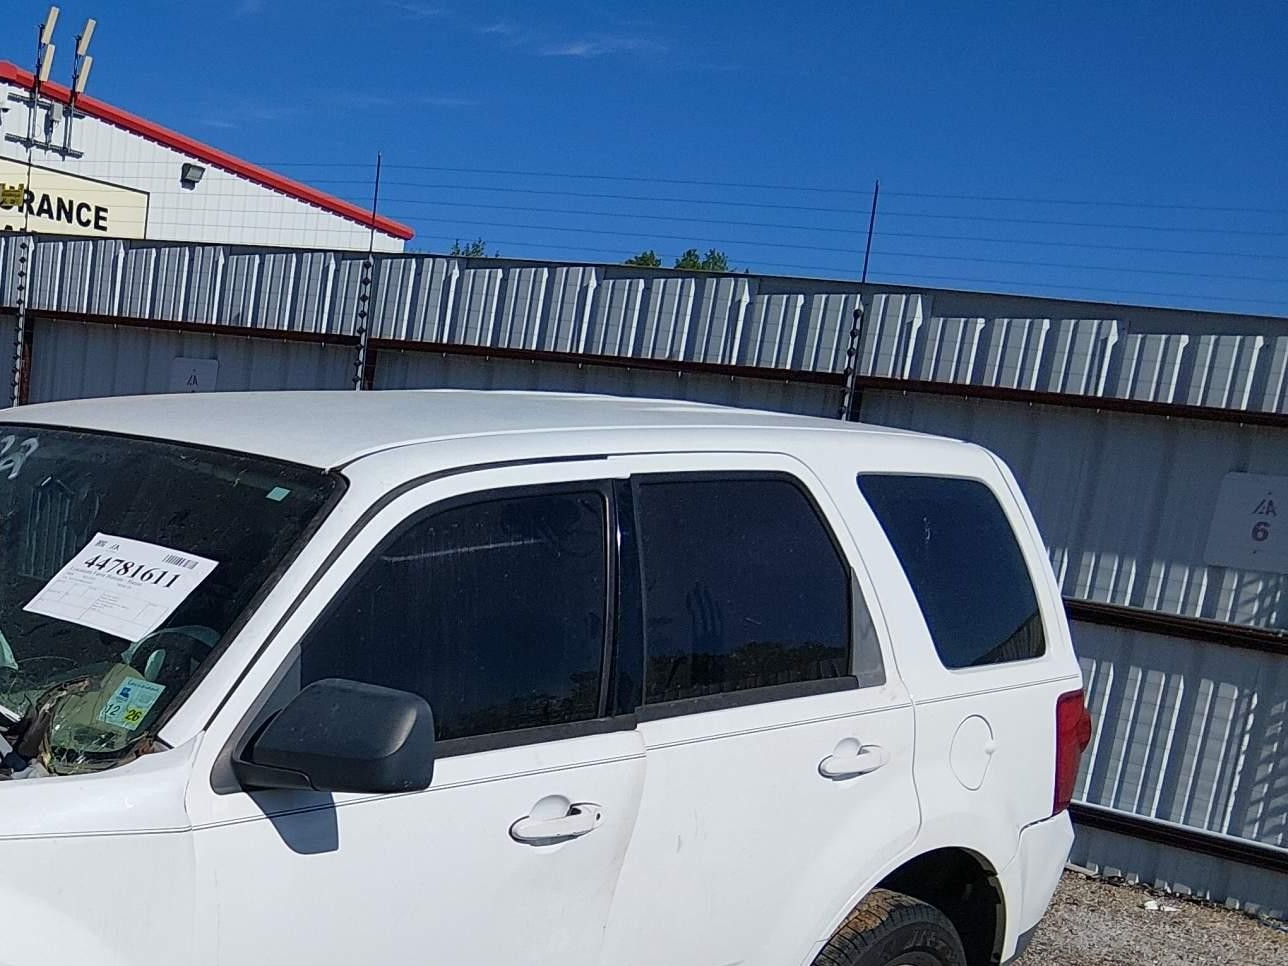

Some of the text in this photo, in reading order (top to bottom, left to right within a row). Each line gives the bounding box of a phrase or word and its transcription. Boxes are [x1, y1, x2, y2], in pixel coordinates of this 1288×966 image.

[1252, 521, 1271, 542] 6
[84, 554, 182, 588] 44781611
[124, 709, 143, 722] 26
